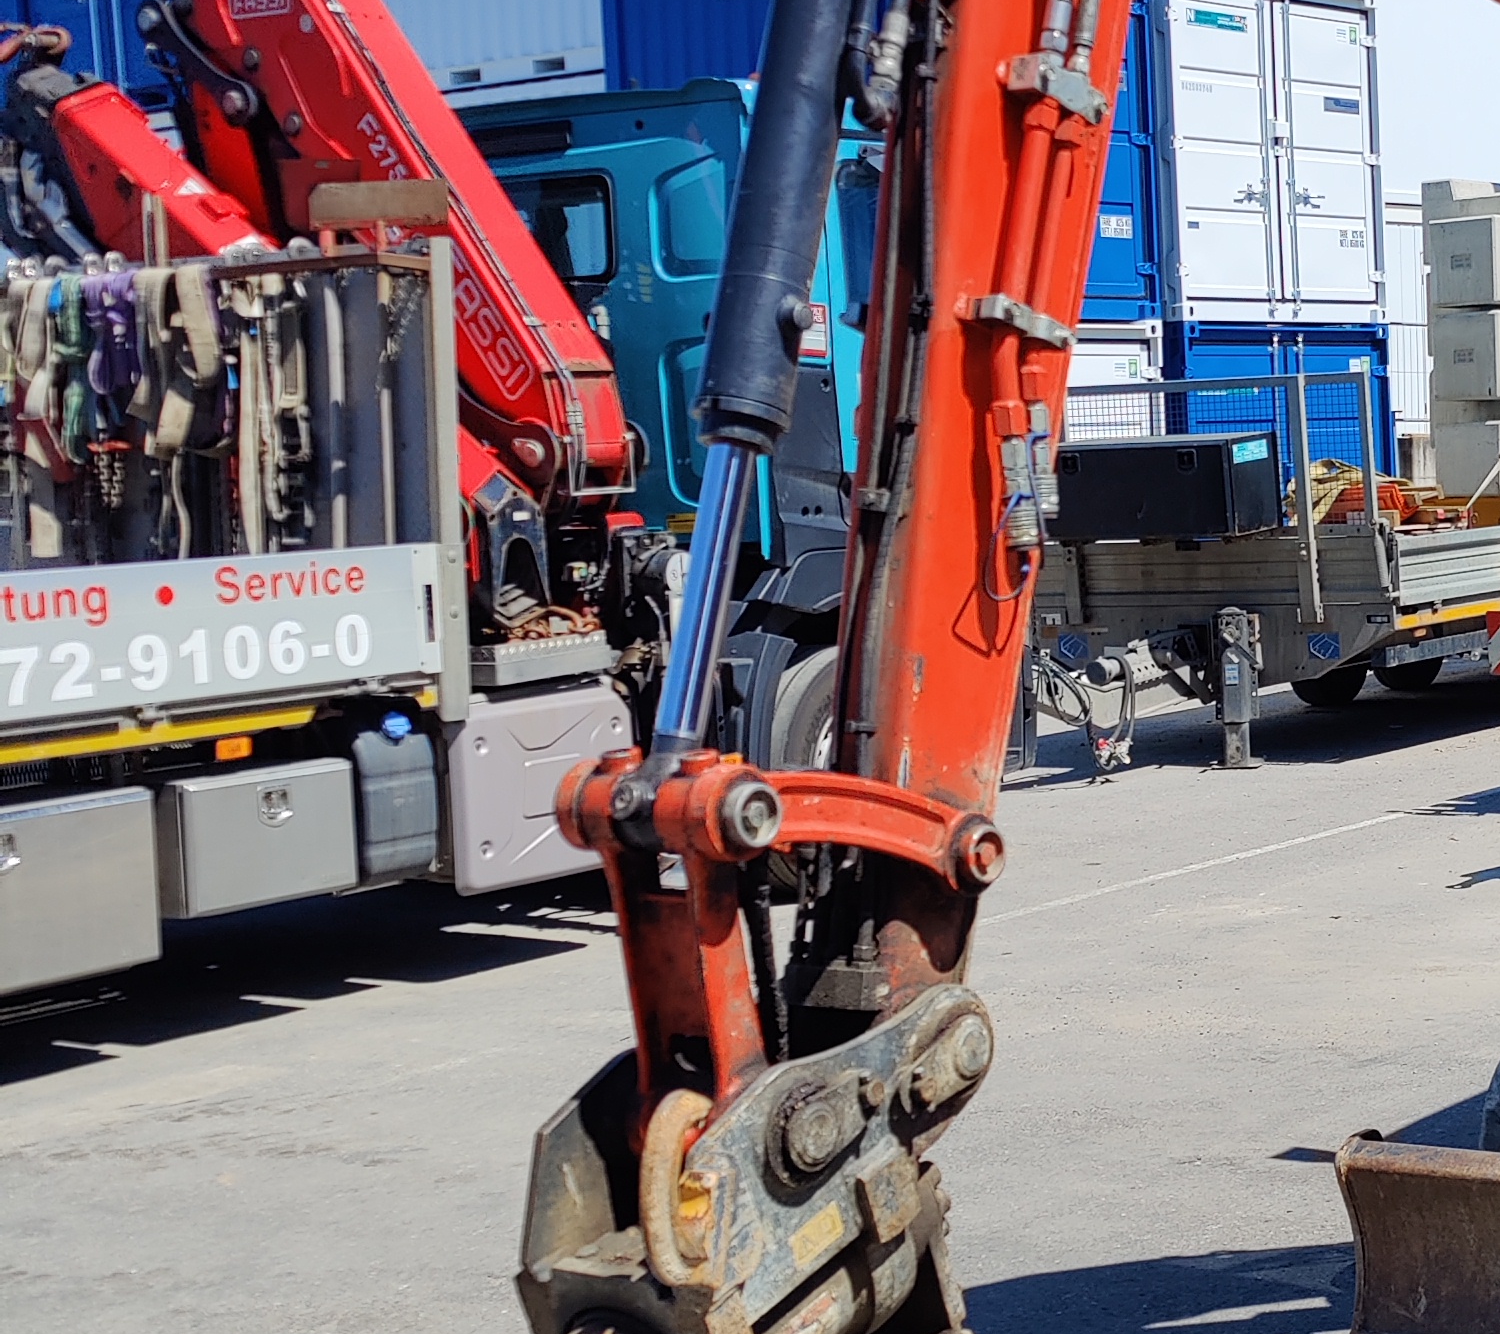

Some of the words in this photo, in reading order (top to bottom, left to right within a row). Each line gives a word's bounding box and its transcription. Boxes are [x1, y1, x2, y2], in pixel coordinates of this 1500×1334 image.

[0, 585, 109, 627] tung
[213, 560, 367, 605] Service
[0, 613, 371, 707] 72-9106-0
